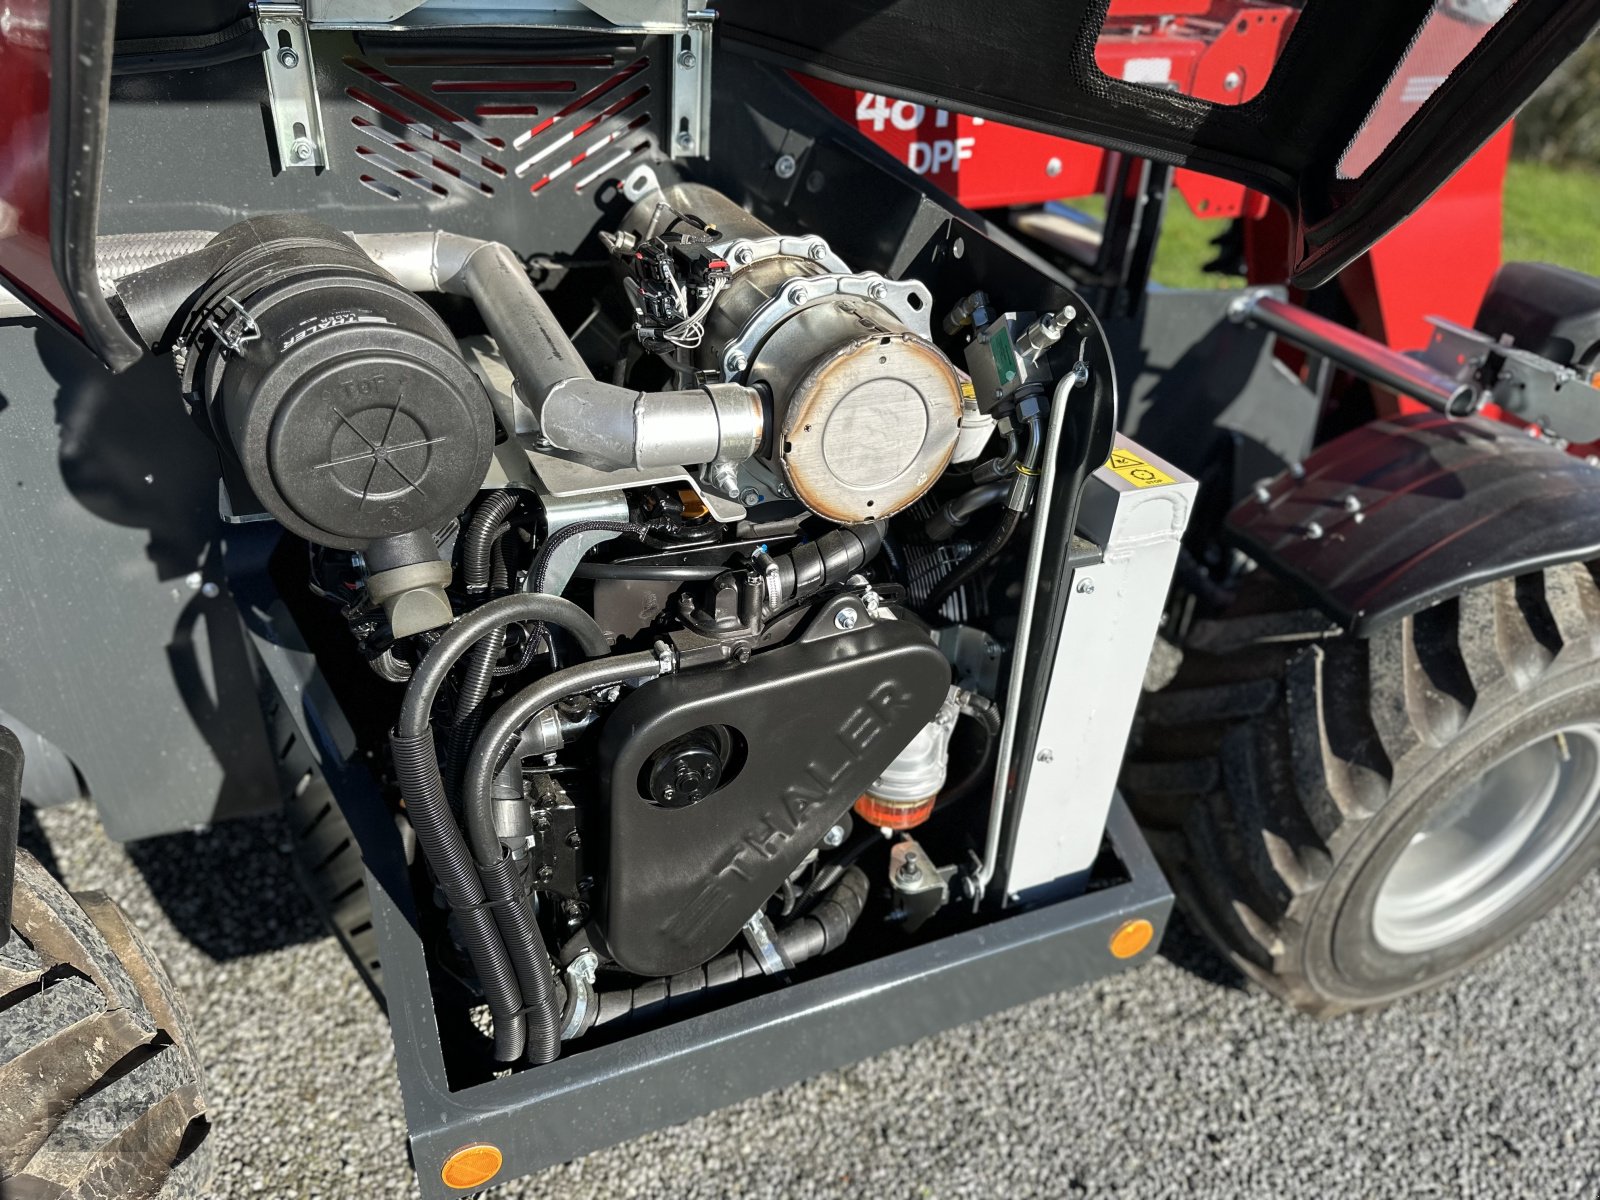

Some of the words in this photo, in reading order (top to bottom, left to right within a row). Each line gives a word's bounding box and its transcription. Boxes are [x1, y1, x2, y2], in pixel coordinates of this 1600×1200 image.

[908, 137, 975, 175] DPF
[283, 317, 355, 348] THALER
[711, 679, 913, 882] THALER
